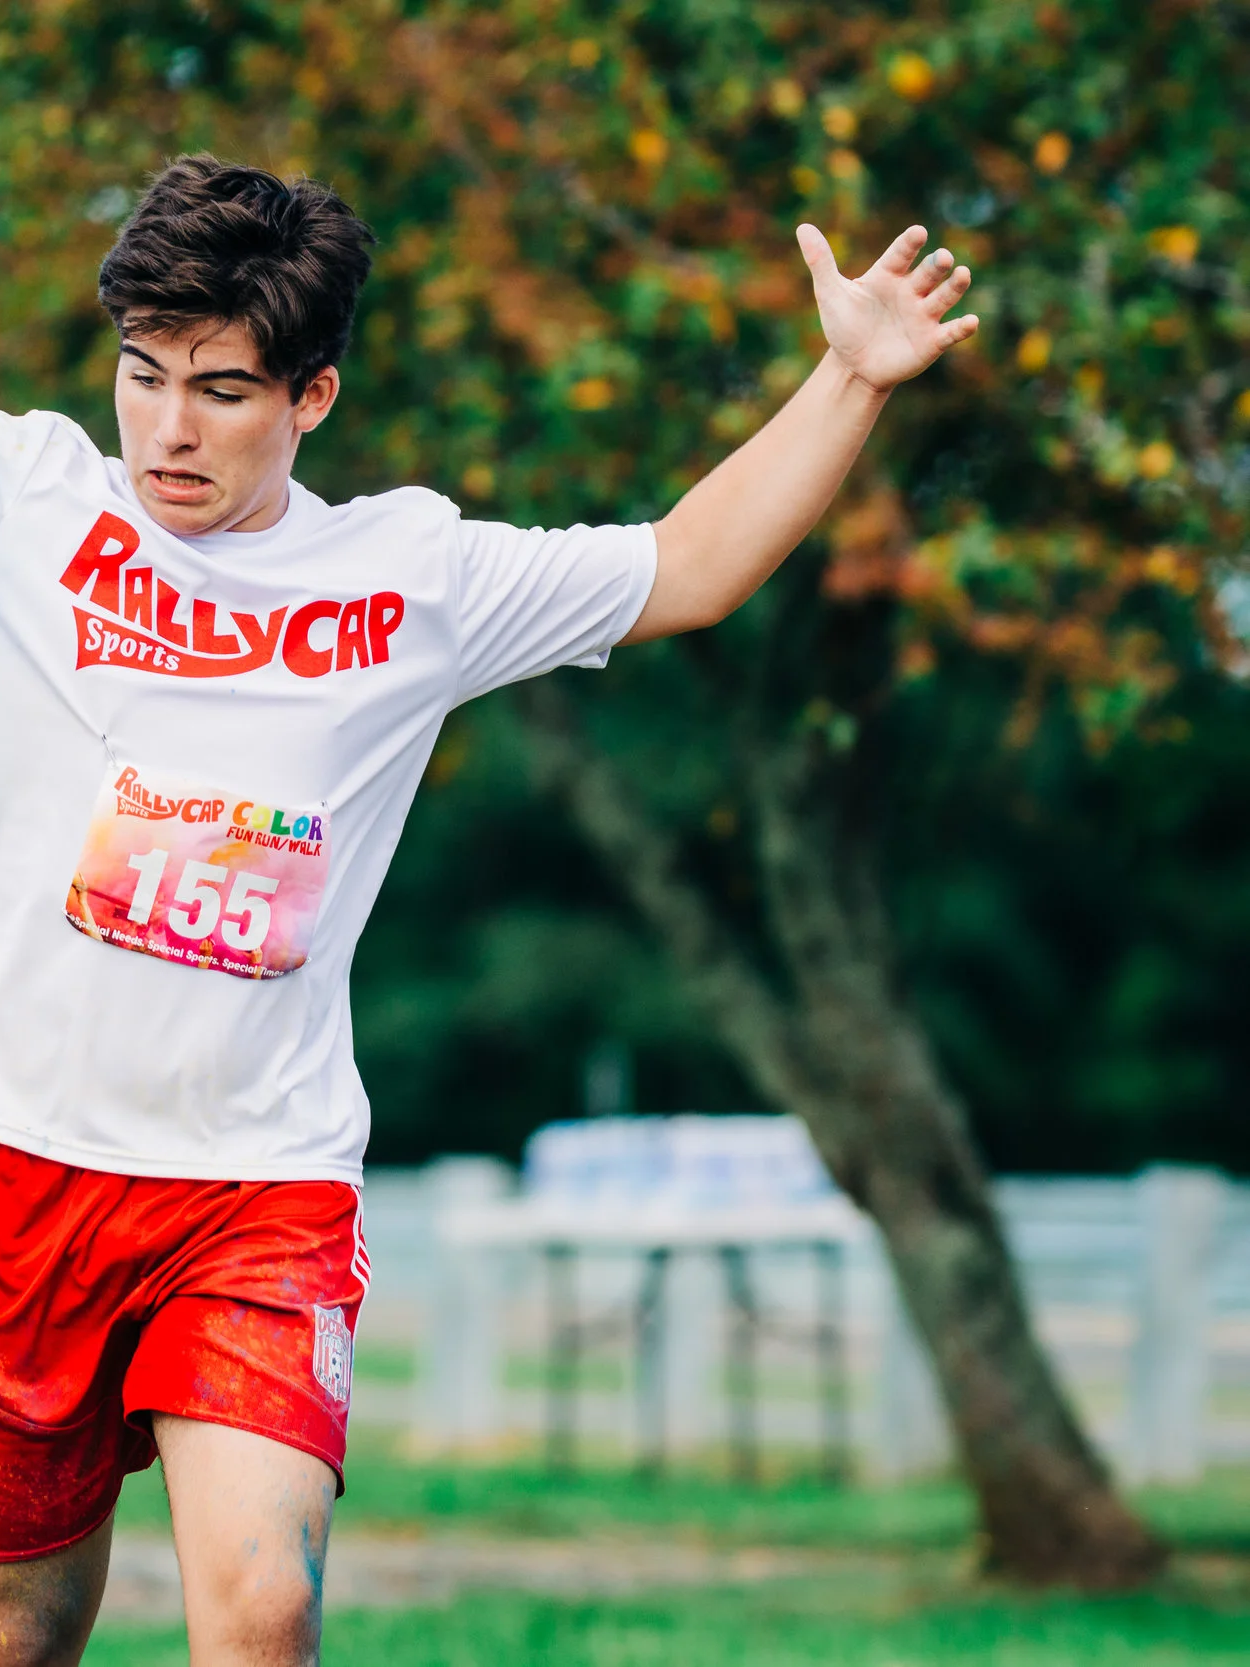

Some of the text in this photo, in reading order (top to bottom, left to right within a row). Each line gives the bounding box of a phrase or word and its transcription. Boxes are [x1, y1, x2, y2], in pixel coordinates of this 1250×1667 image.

[84, 618, 180, 671] Sports
[118, 798, 149, 818] Sports
[232, 801, 323, 841] COLOR
[226, 826, 322, 857] FUN RUN/WALK
[126, 848, 280, 951] 155
[74, 915, 110, 938] Speial
[112, 929, 145, 947] Needs.
[147, 940, 184, 958] Special
[186, 949, 219, 966] Sports.
[222, 957, 258, 974] Special
